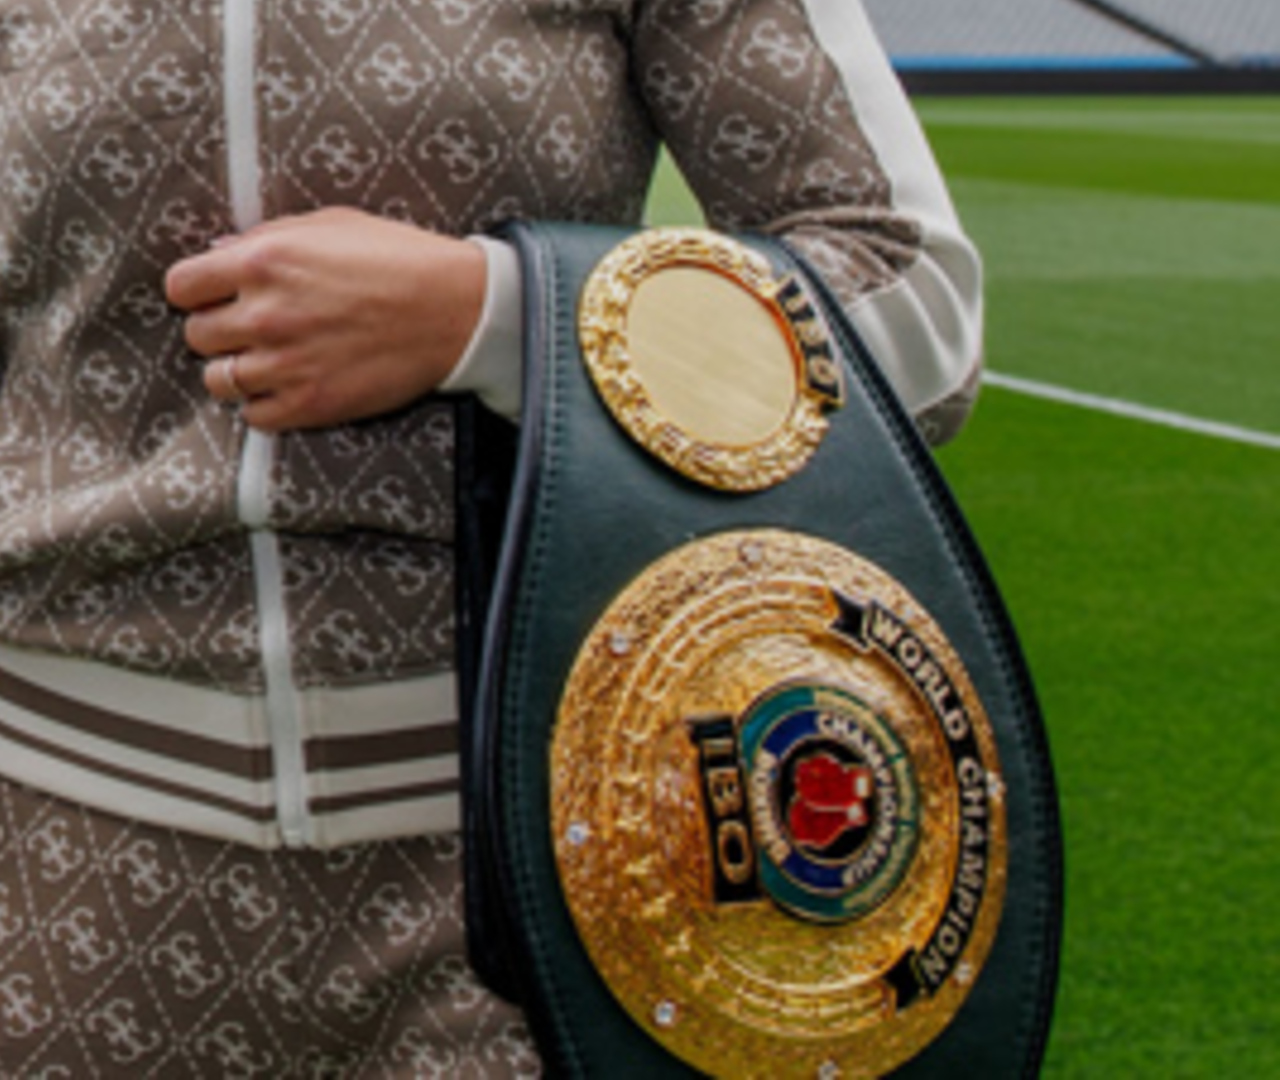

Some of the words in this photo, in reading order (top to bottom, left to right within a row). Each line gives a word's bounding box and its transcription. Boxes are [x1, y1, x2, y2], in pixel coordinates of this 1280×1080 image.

[870, 610, 971, 741] WORLD
[702, 738, 754, 885] IBO
[917, 755, 987, 986] CHAMPION
